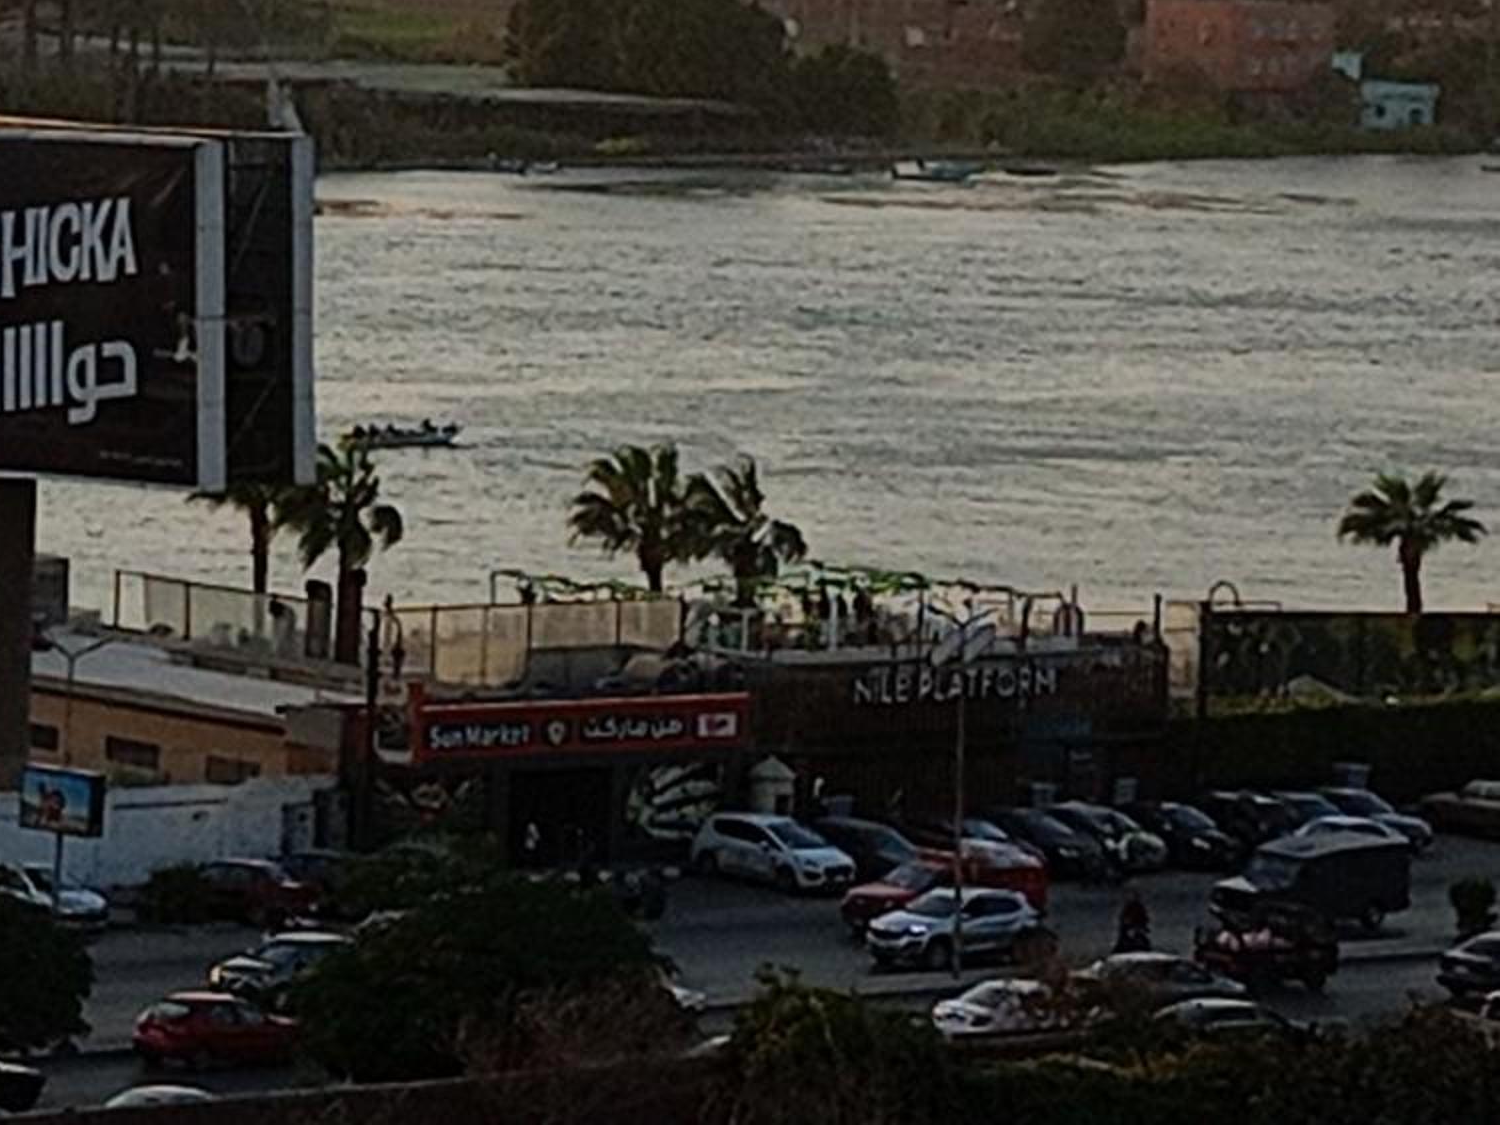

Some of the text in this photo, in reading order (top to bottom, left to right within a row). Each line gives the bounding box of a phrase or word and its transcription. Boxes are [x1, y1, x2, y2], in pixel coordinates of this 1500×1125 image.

[853, 666, 1057, 704] NILE PLATFORM
[429, 723, 530, 749] Sun Market
[583, 714, 647, 739] ماركت
